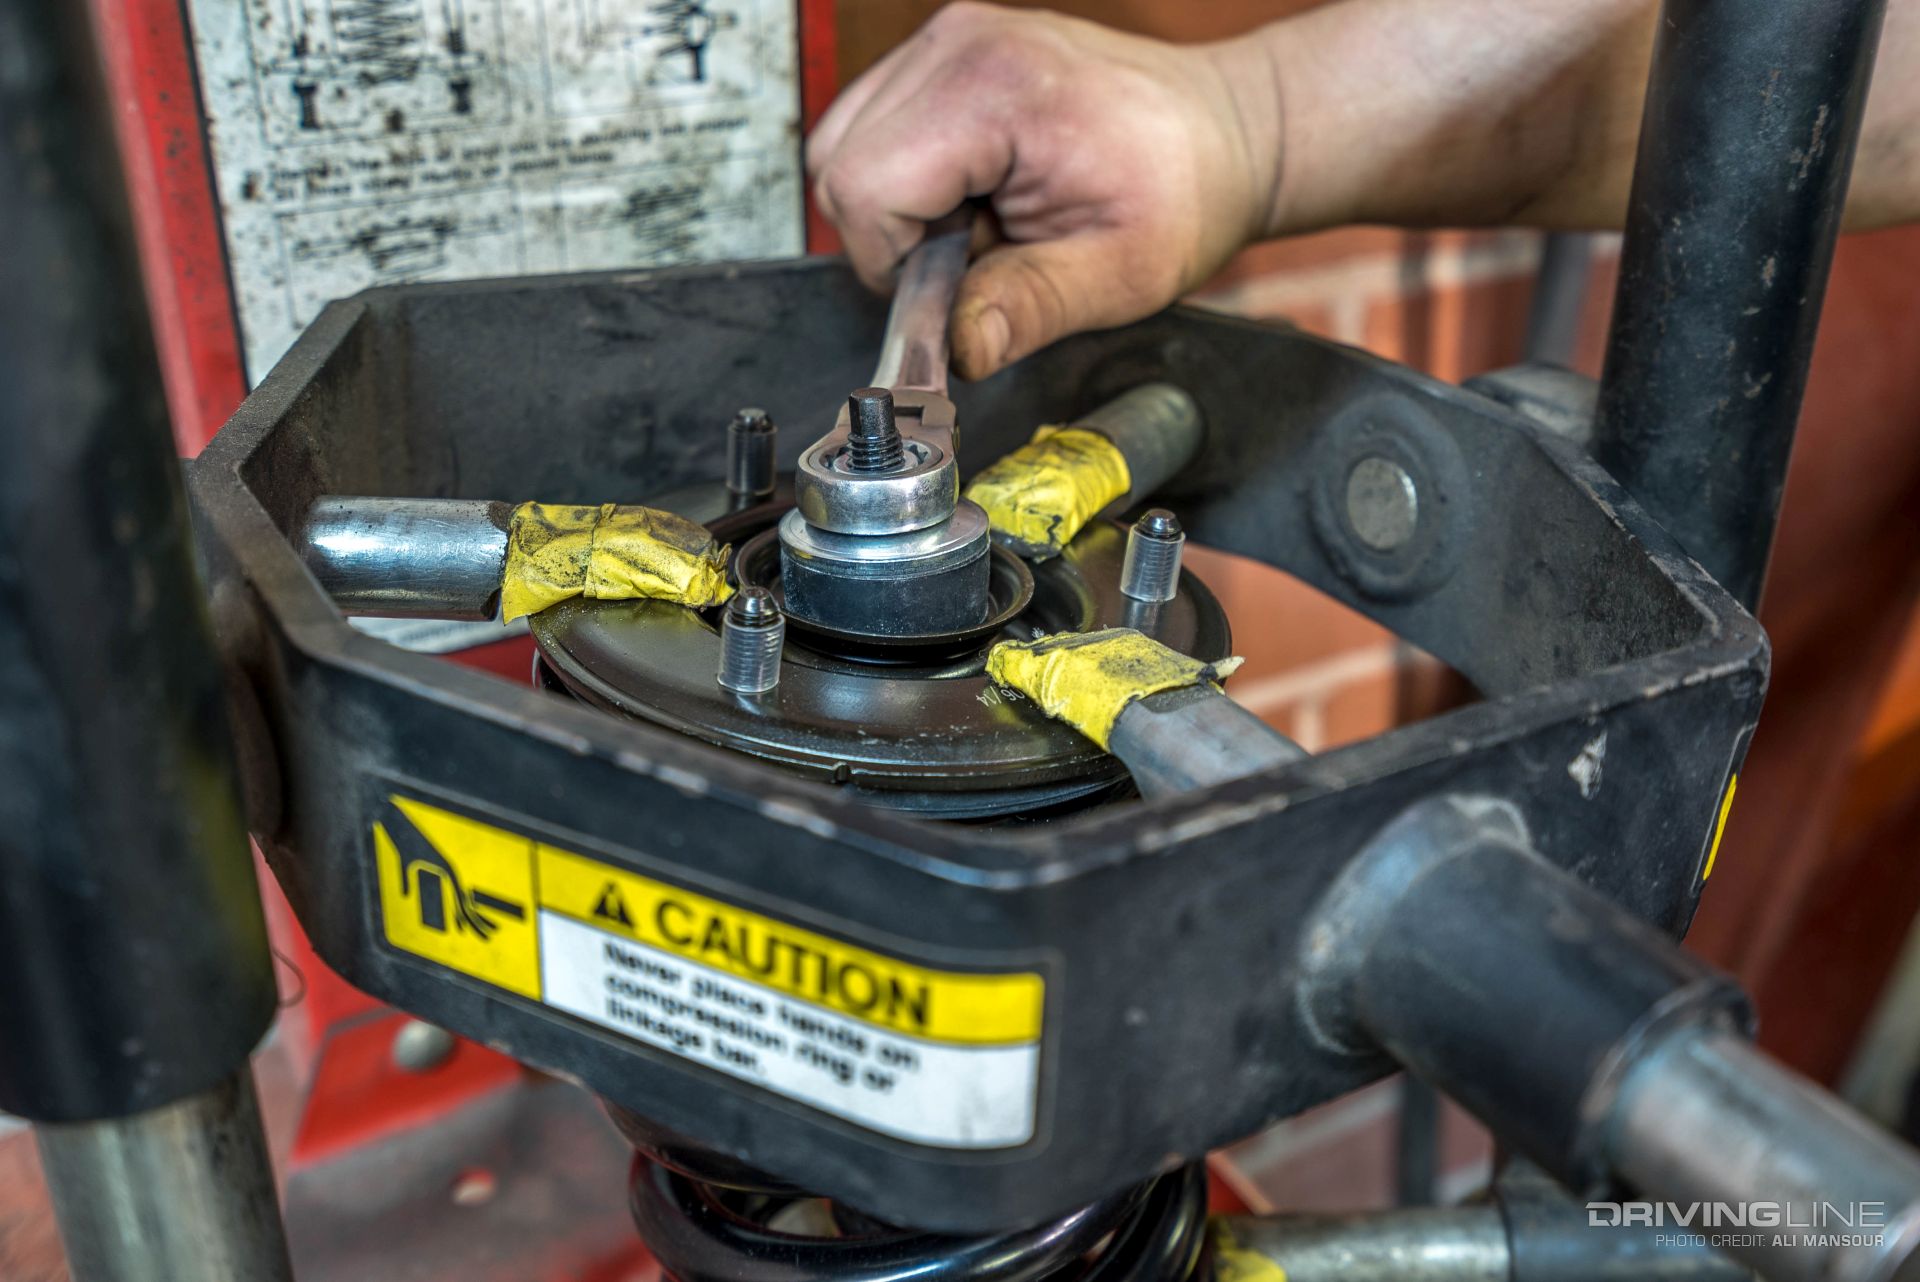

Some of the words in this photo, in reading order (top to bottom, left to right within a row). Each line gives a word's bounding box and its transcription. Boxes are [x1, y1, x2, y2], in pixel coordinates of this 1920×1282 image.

[604, 942, 681, 983] Never
[689, 977, 765, 1018] place
[775, 1003, 867, 1055] hands
[877, 1041, 920, 1072] on
[605, 996, 704, 1050] linkage
[656, 899, 930, 1028] CAUTION
[605, 976, 789, 1054] compression
[796, 1041, 854, 1085] ring
[861, 1065, 896, 1093] or
